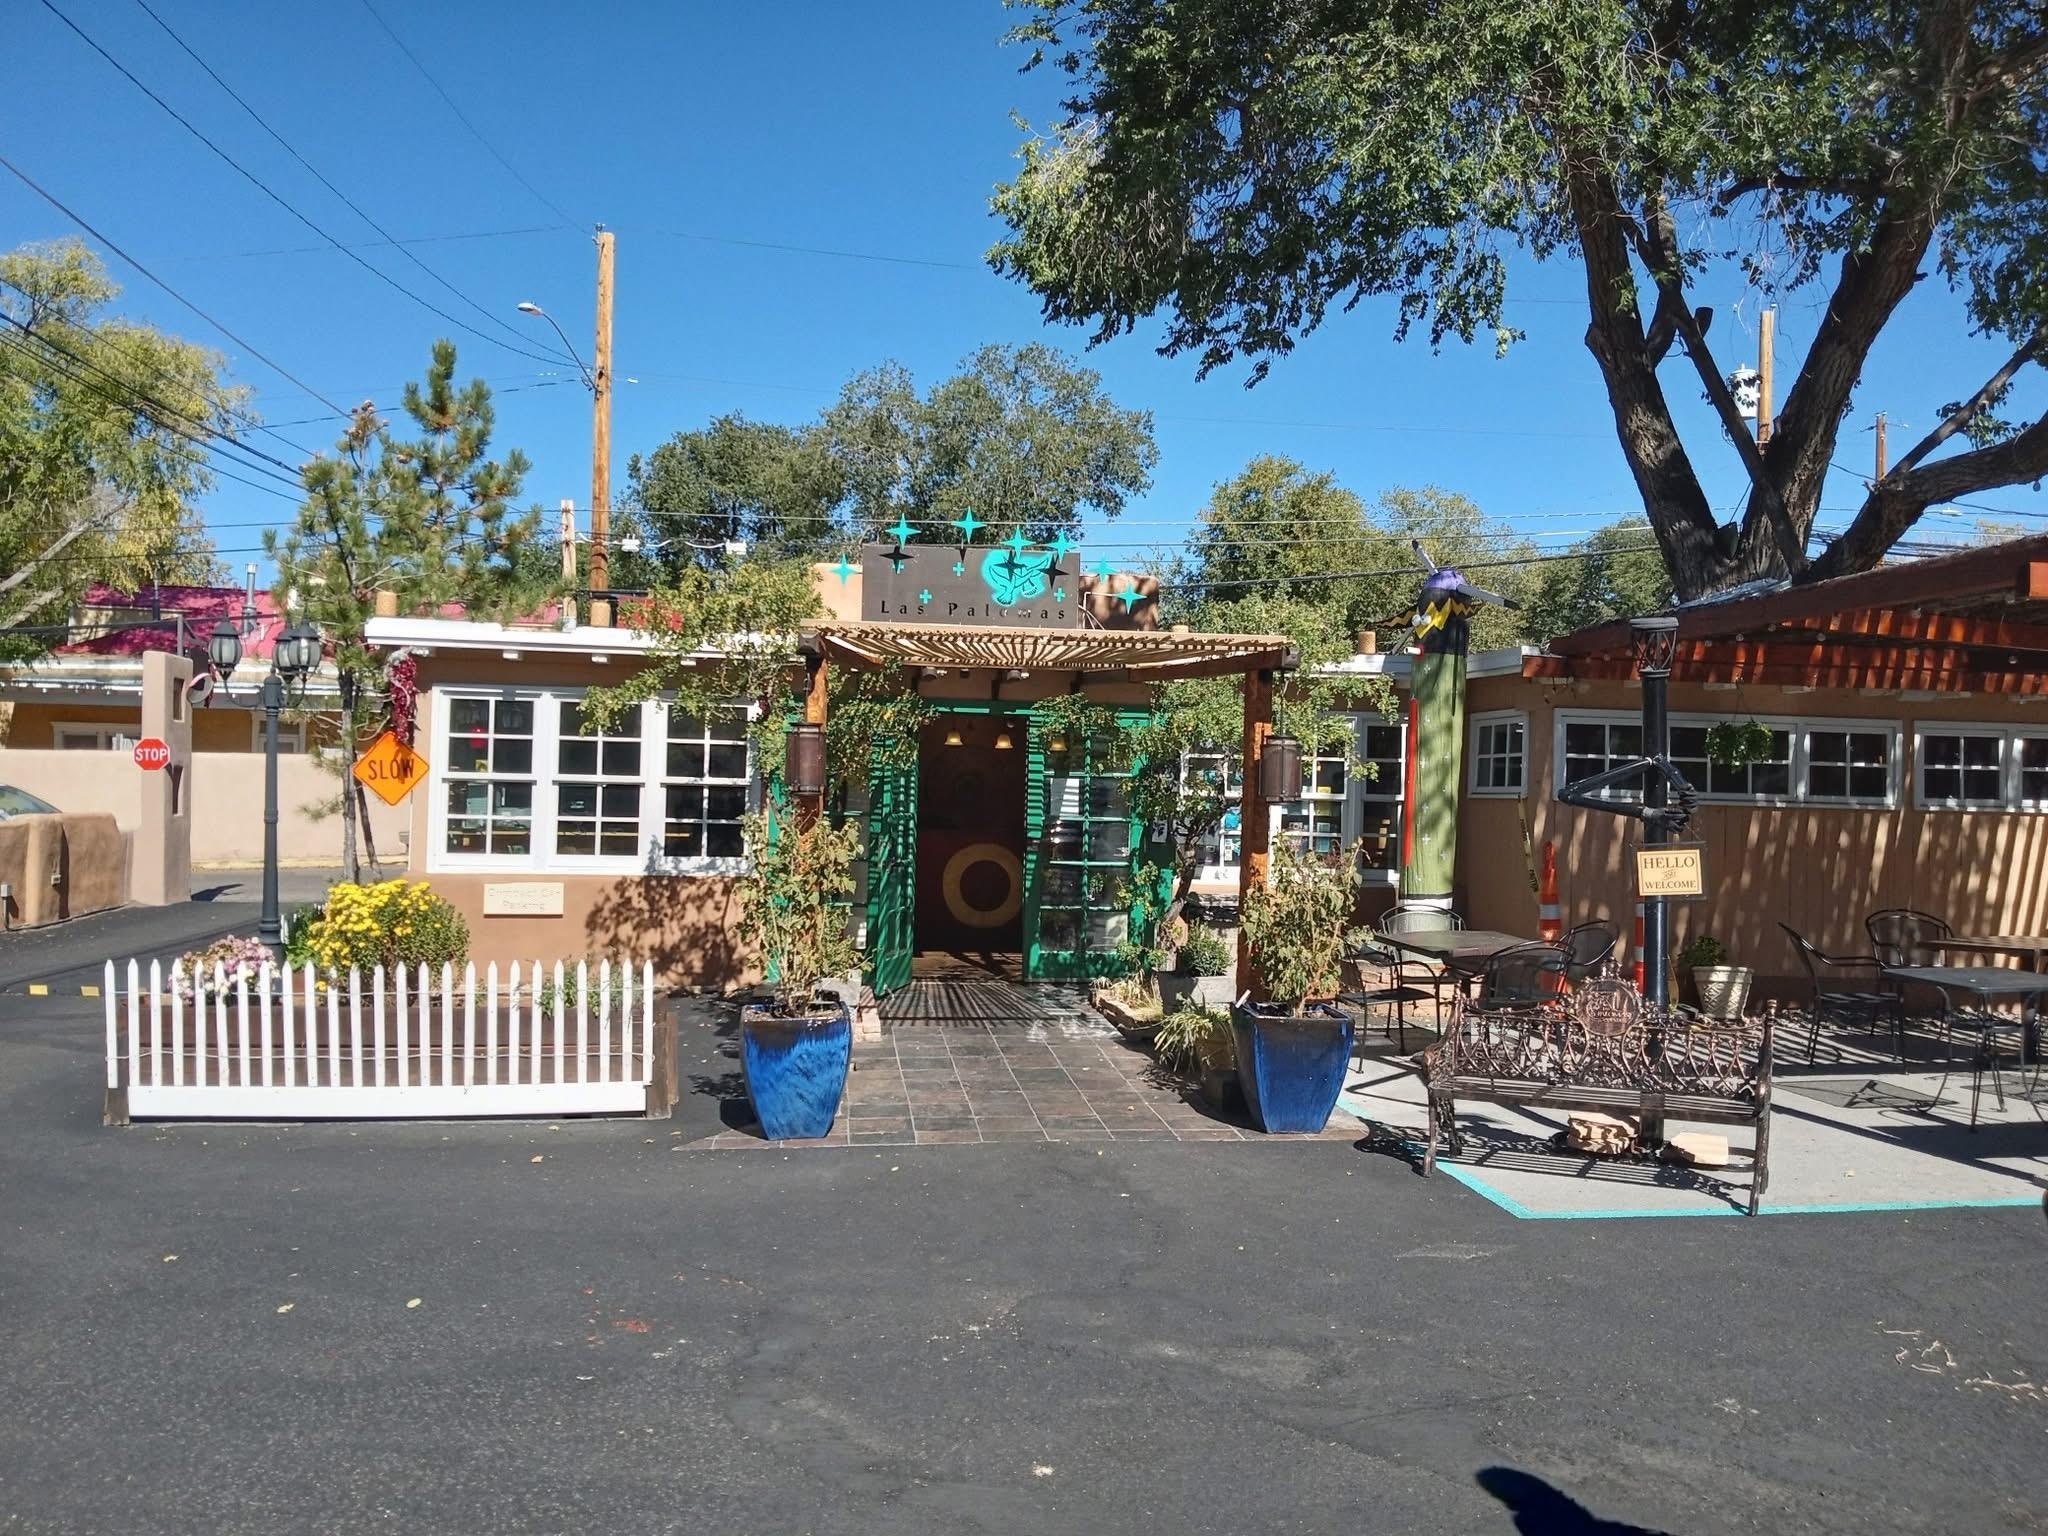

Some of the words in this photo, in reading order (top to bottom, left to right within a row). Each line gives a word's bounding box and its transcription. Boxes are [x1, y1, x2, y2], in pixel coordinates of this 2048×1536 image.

[881, 600, 924, 615] Las
[135, 748, 167, 761] STOP
[368, 759, 414, 780] SLOW
[1644, 856, 1695, 869] HELLO
[1645, 880, 1697, 889] WELCOME
